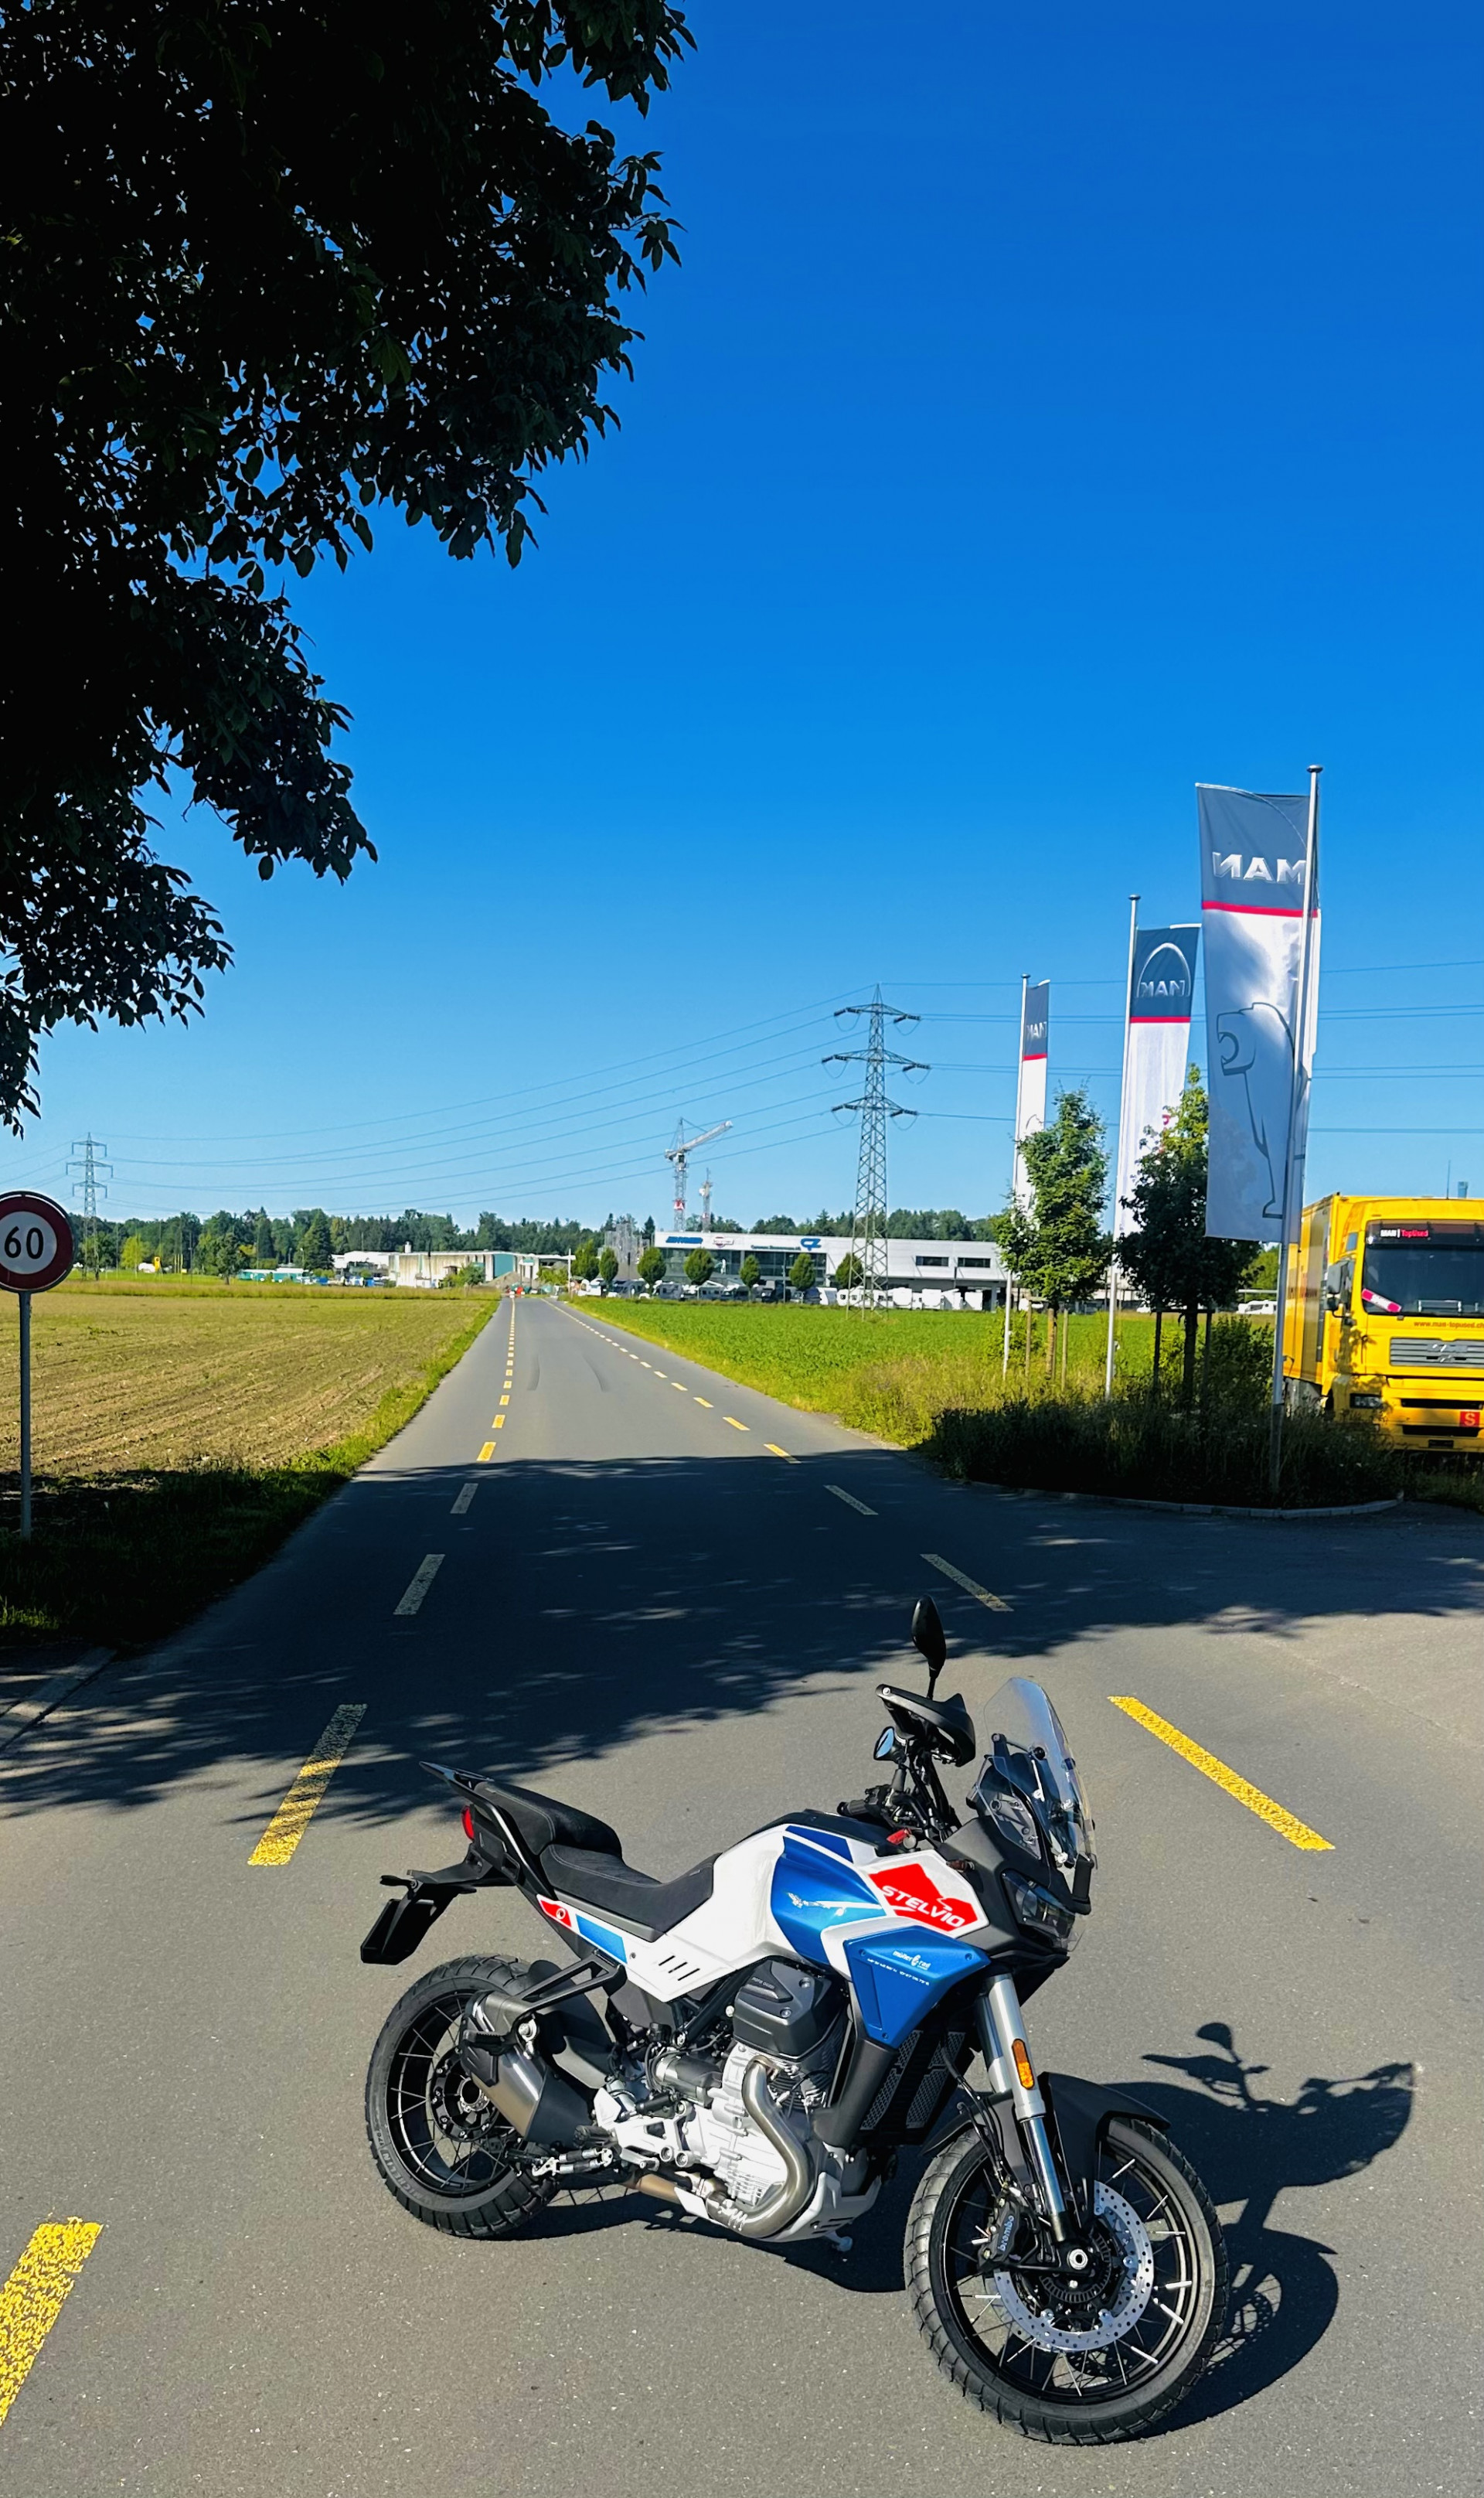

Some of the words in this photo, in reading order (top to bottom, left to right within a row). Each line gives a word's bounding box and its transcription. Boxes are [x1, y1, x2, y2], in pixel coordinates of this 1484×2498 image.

[1140, 980, 1185, 997] MAN
[1026, 1021, 1047, 1038] MAN
[5, 1227, 44, 1259] 60
[1464, 1413, 1475, 1426] S
[882, 1885, 965, 1927] STELVIO
[382, 2152, 424, 2200] MICHELIN
[997, 2215, 1015, 2251] brembo
